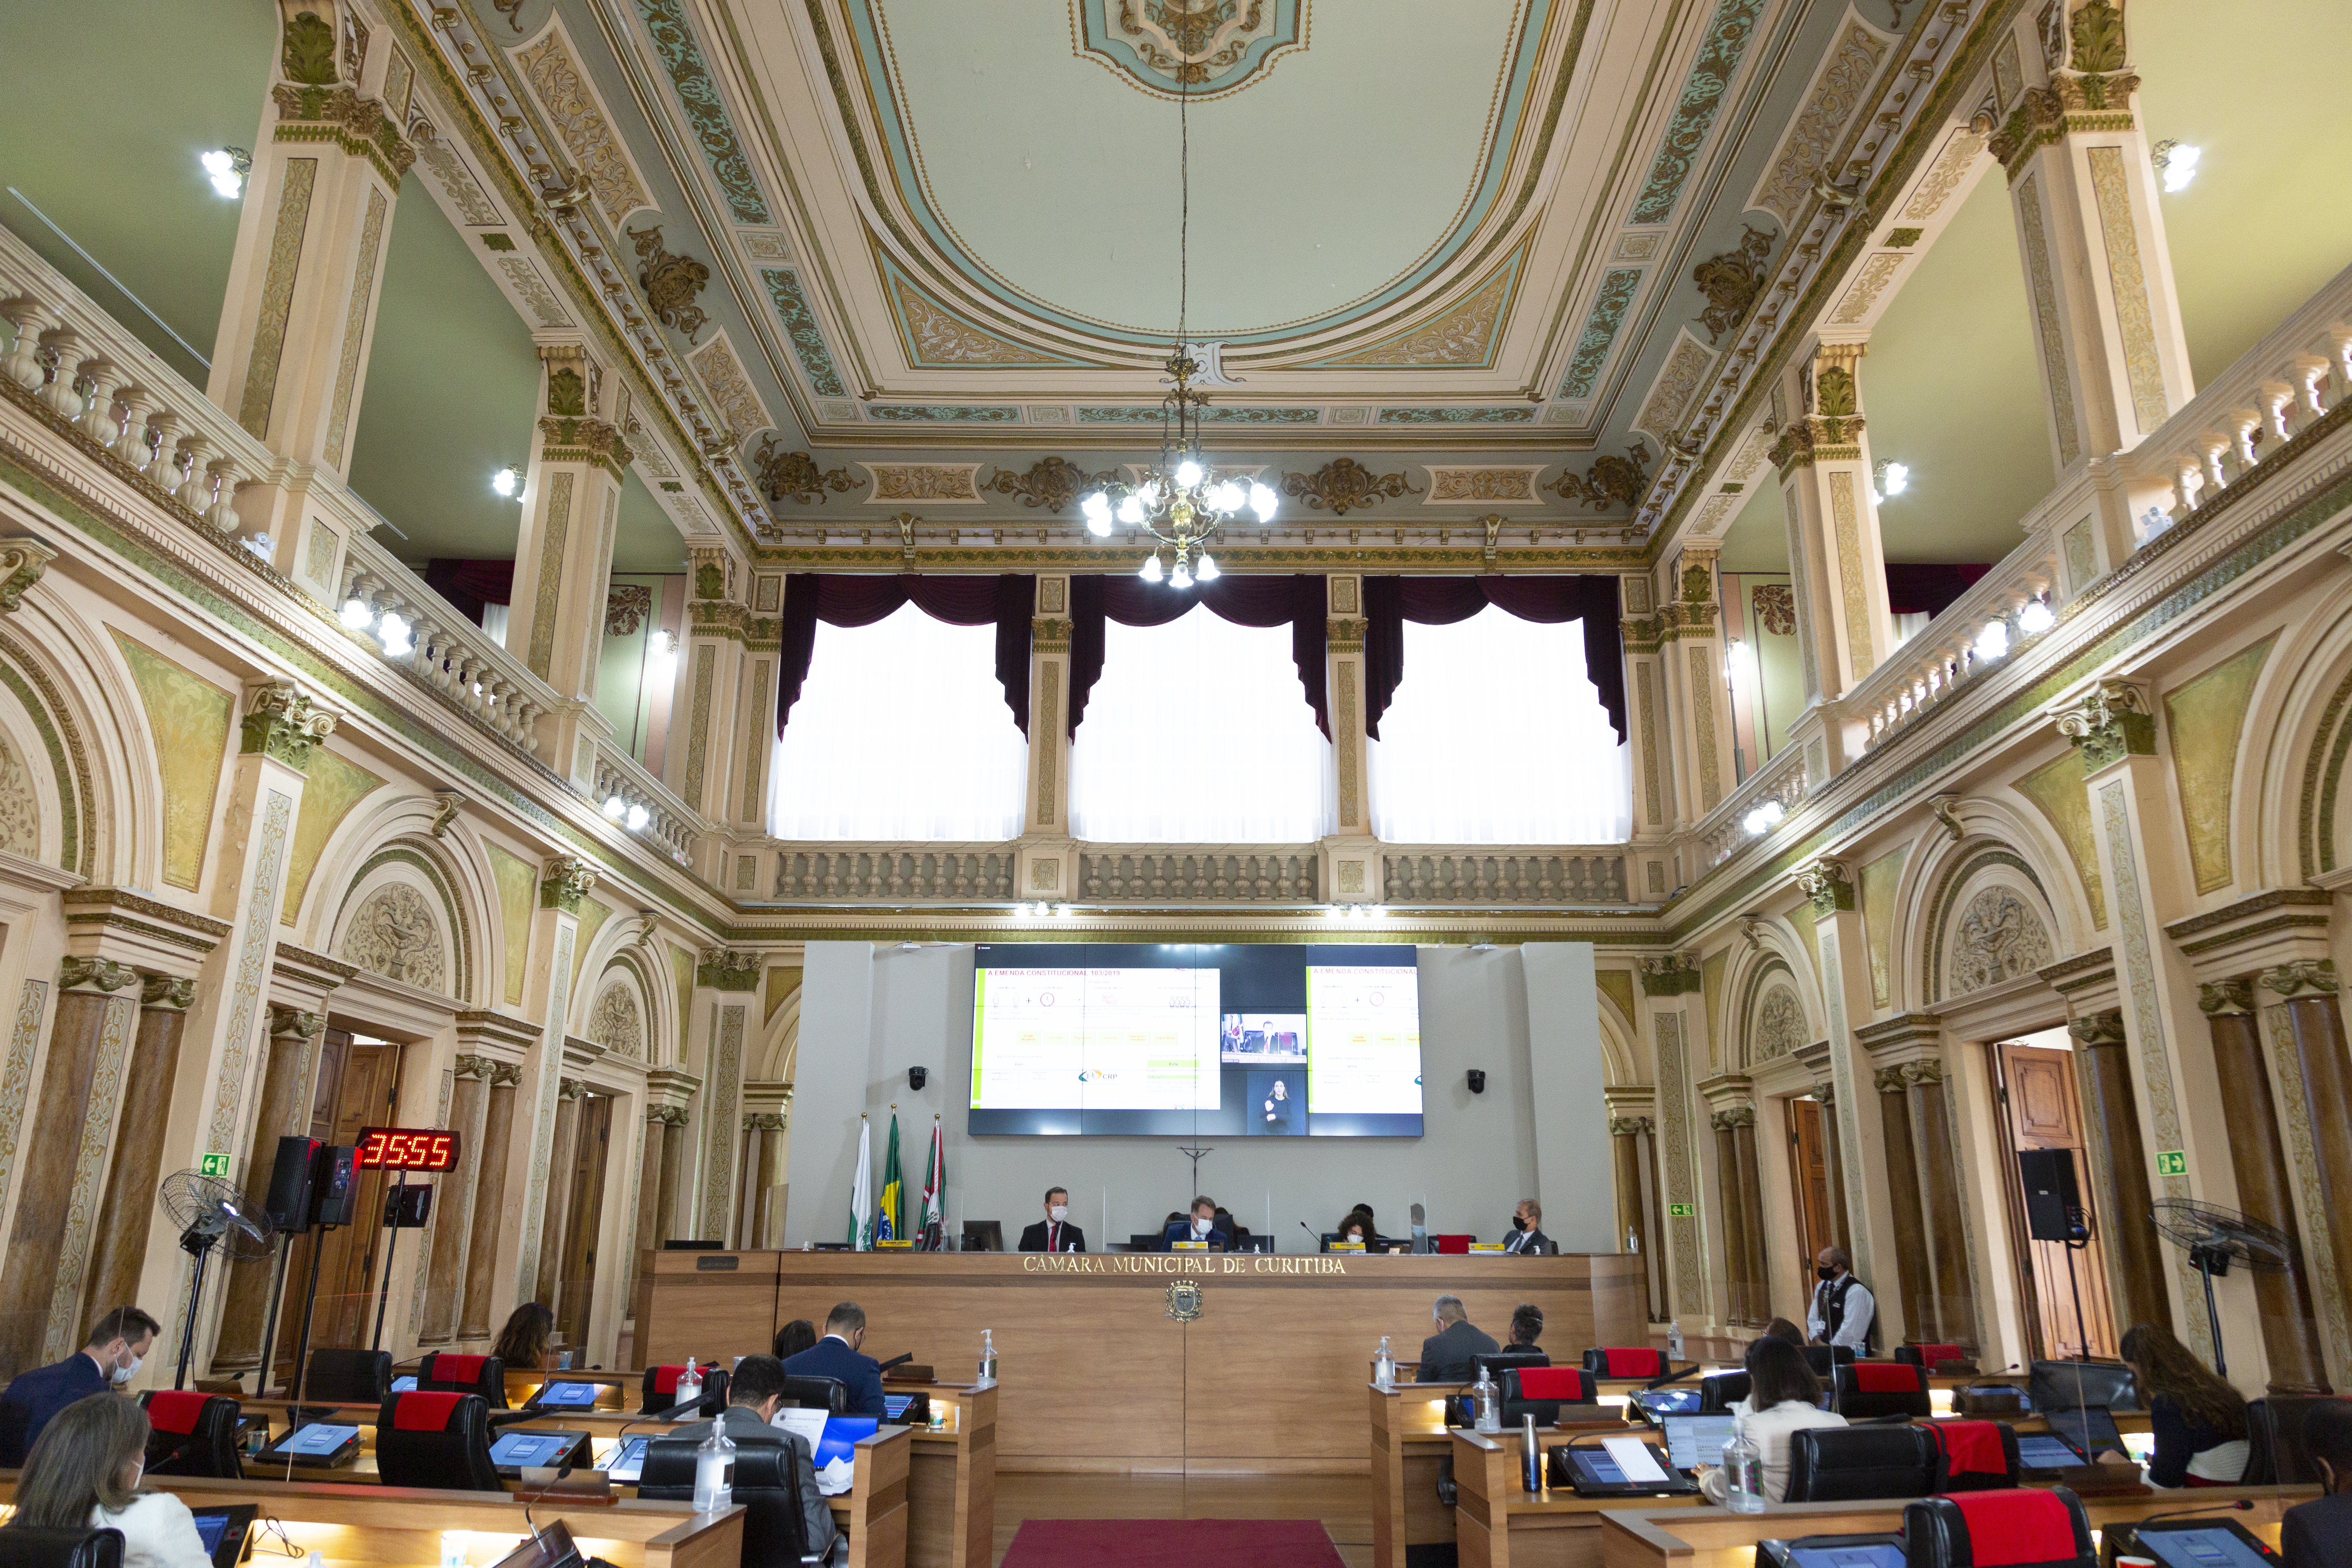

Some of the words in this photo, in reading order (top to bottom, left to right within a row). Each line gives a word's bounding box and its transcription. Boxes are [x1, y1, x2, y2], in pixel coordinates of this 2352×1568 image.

[364, 1134, 450, 1166] 35:55
[1023, 1254, 1106, 1272] CÂMARA
[1113, 1256, 1216, 1273] MUNICIPAL
[1223, 1257, 1246, 1273] DE
[1255, 1257, 1346, 1274] CURITIBA
